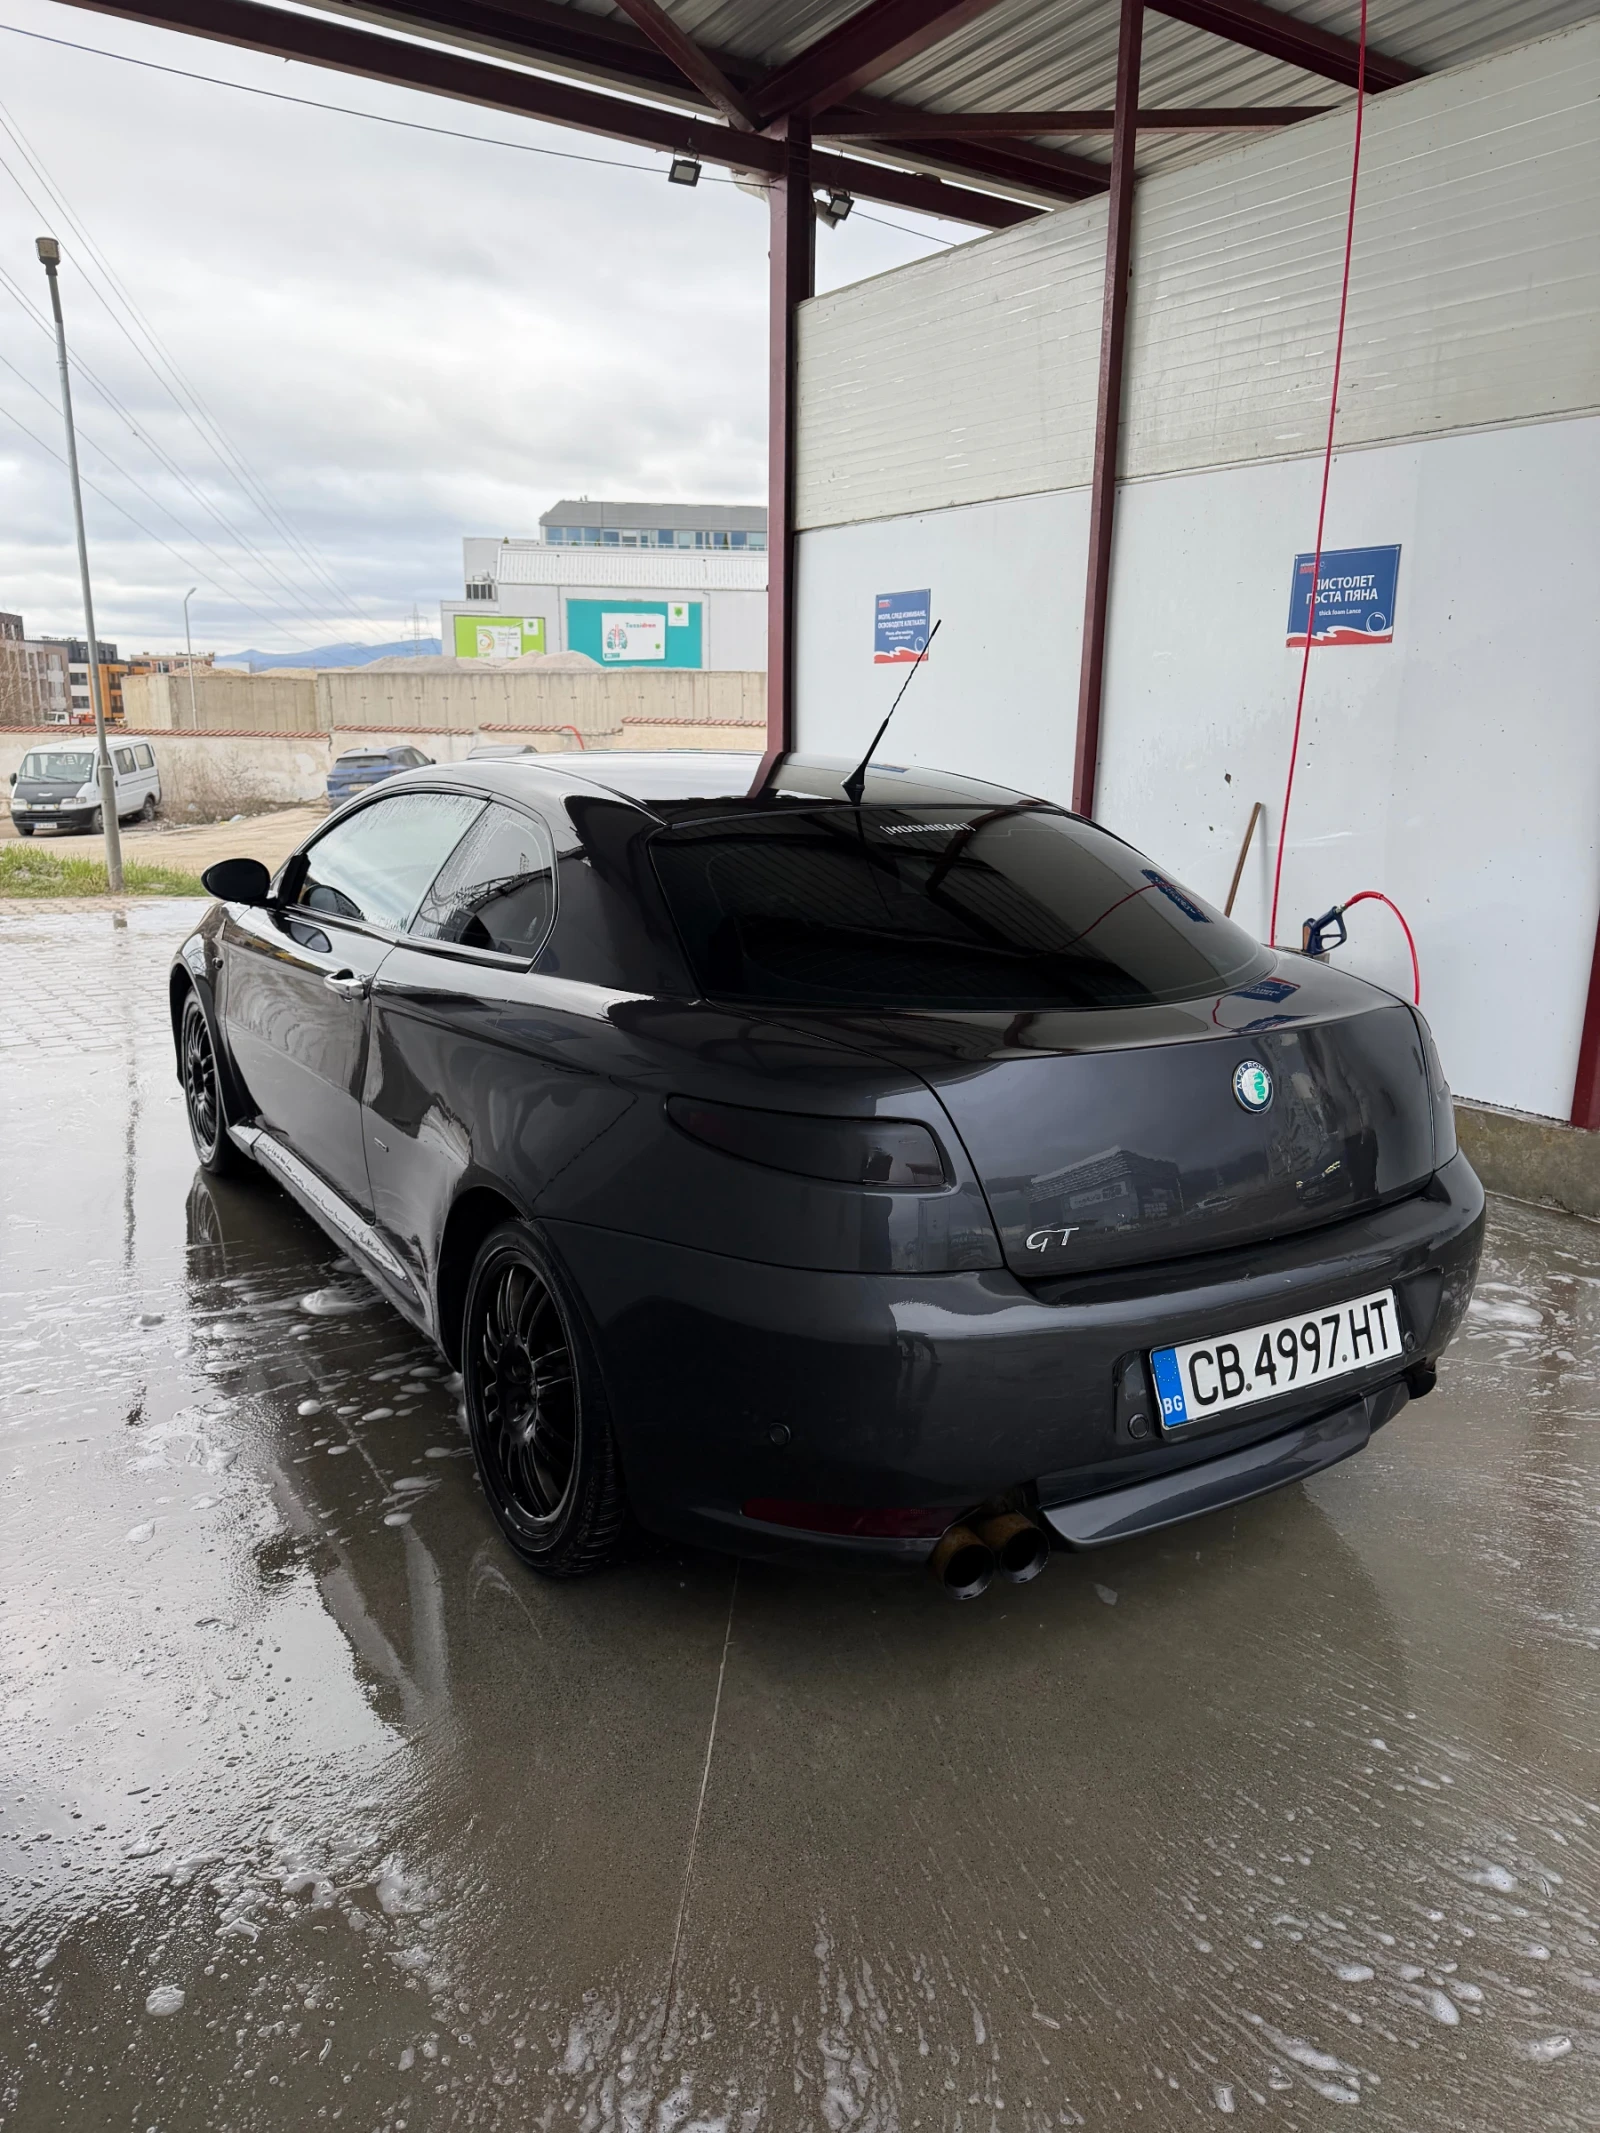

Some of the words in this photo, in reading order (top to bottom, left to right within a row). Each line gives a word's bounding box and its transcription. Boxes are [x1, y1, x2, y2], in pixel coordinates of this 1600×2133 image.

[1344, 588, 1378, 602] ПЯНА
[1236, 1066, 1247, 1090] ALFA
[1247, 1062, 1272, 1084] ROMEO
[1026, 1227, 1080, 1253] GT
[1162, 1396, 1183, 1415] BG
